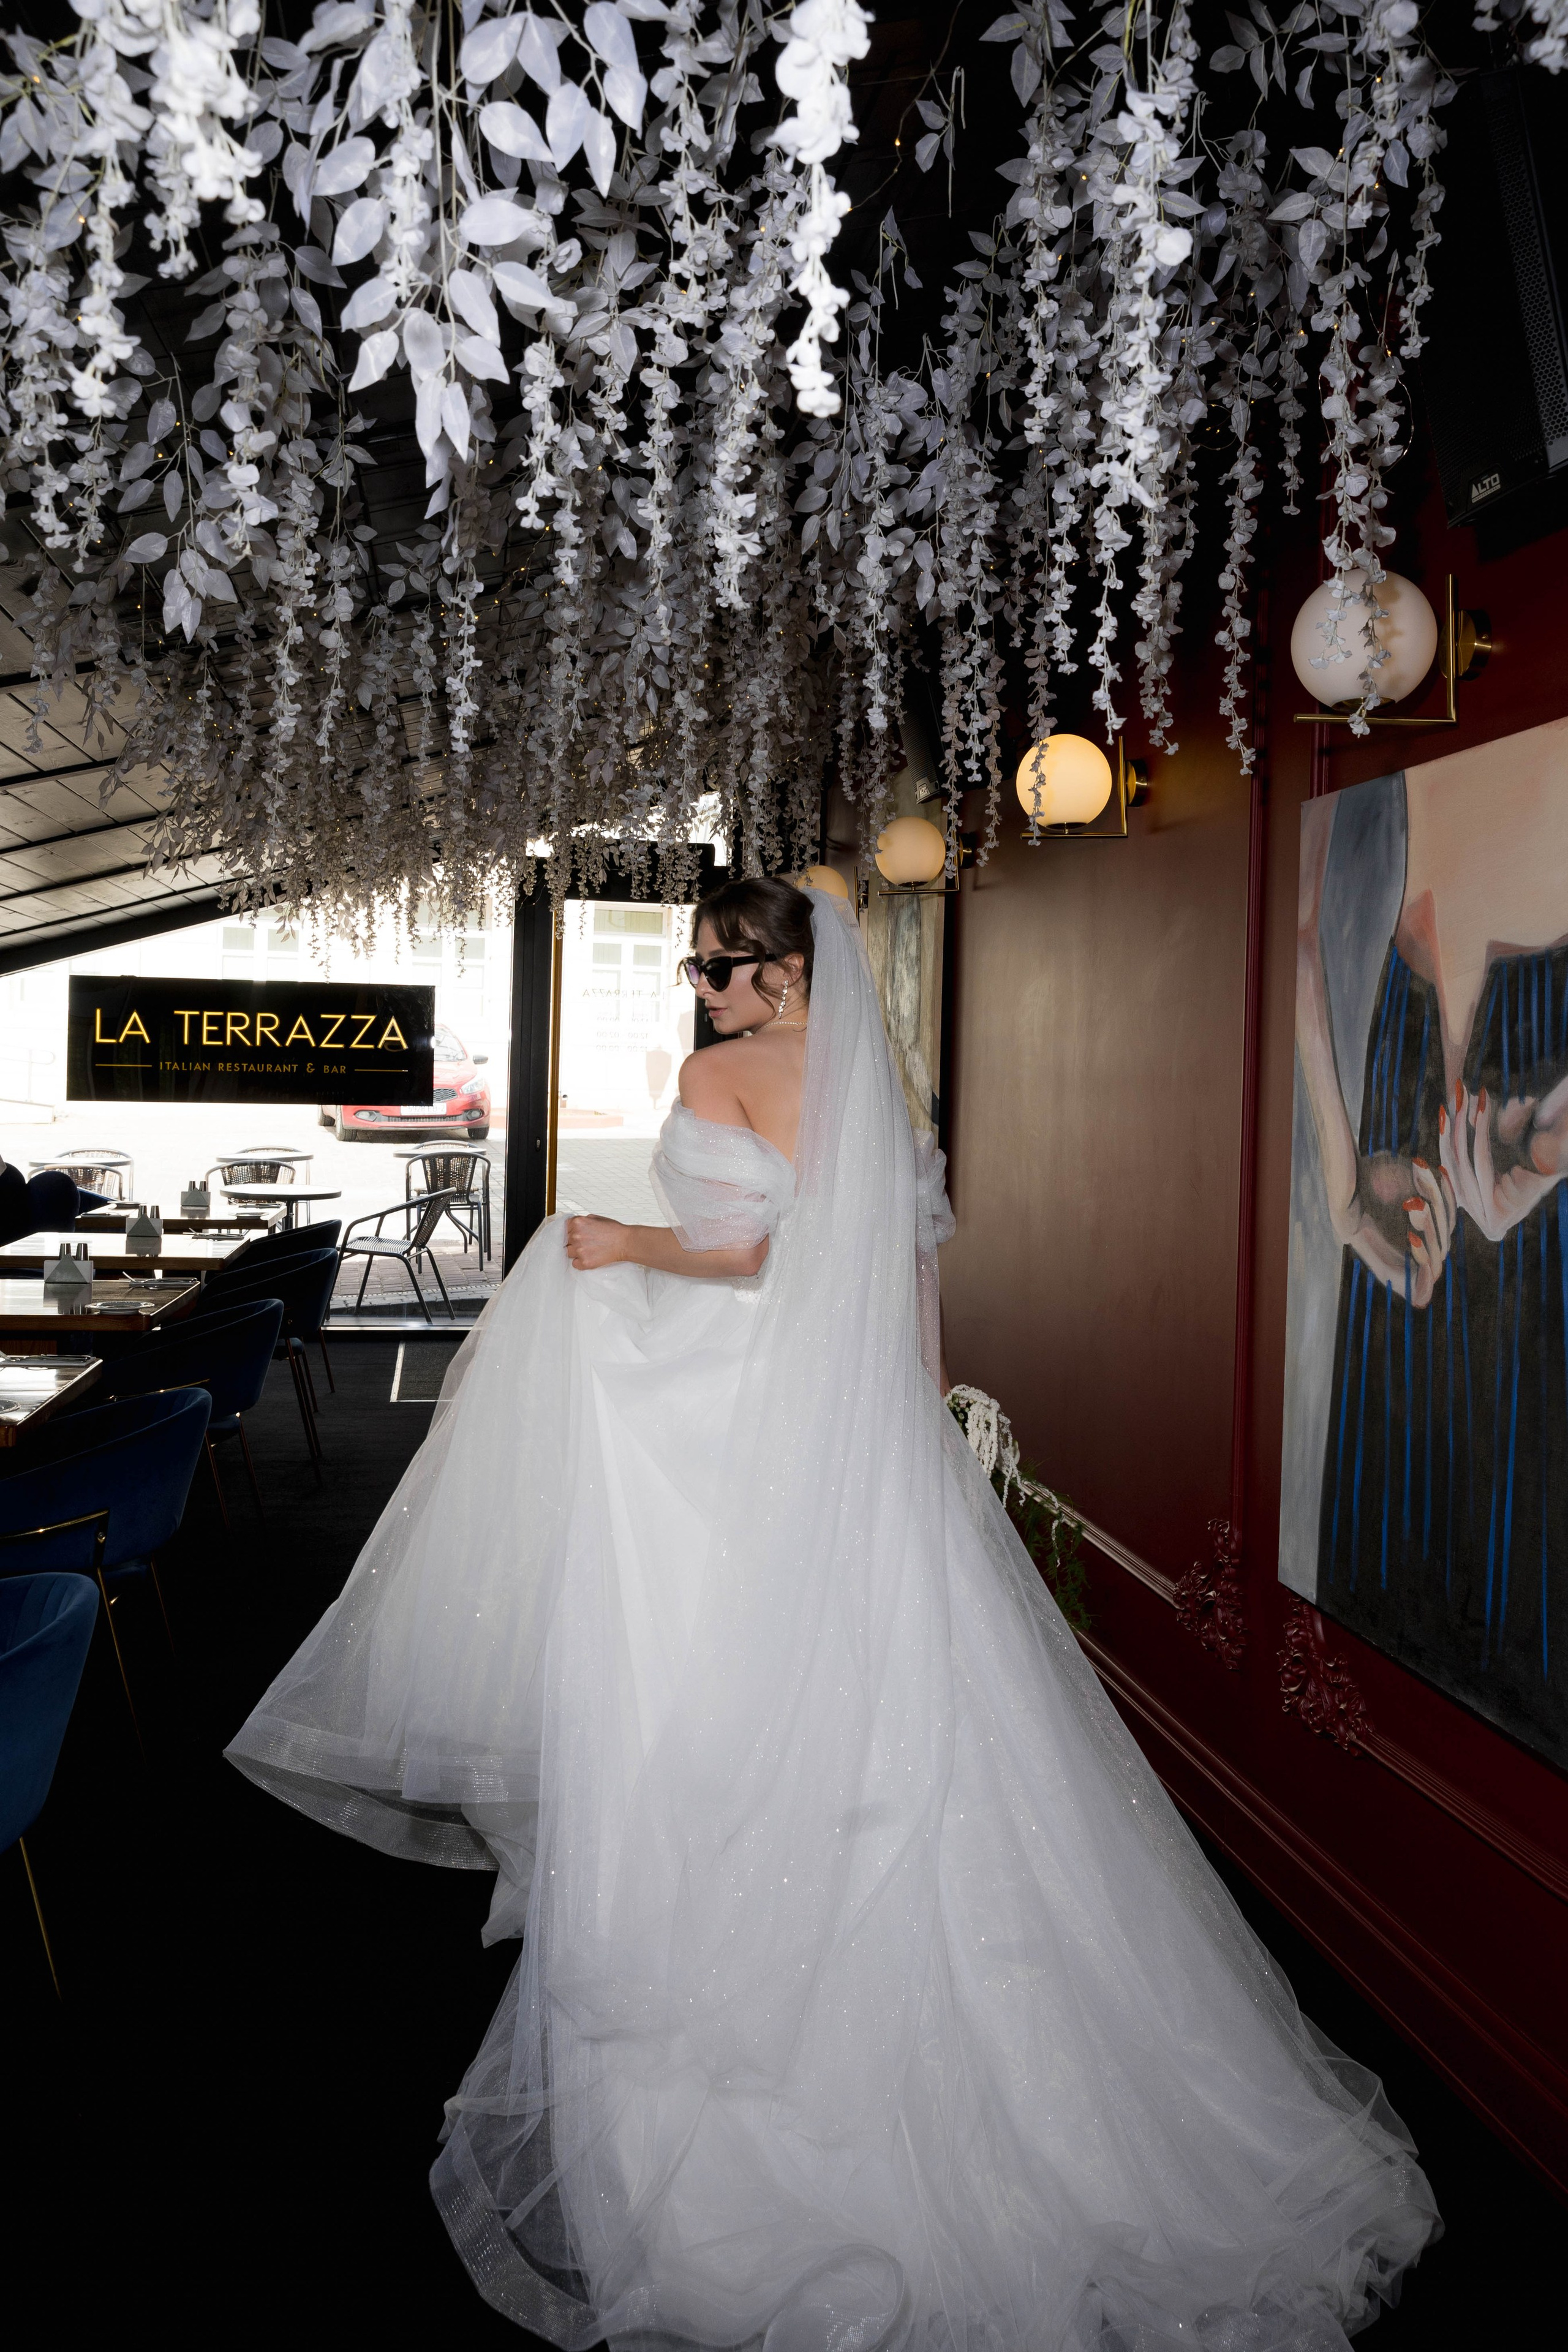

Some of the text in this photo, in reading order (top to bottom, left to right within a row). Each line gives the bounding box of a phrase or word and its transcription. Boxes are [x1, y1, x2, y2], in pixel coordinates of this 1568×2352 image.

[1471, 473, 1500, 498] ALTO
[96, 1008, 407, 1049] LA TERRAZZA
[219, 1063, 297, 1072] RESTAURANT
[306, 1063, 314, 1072] &
